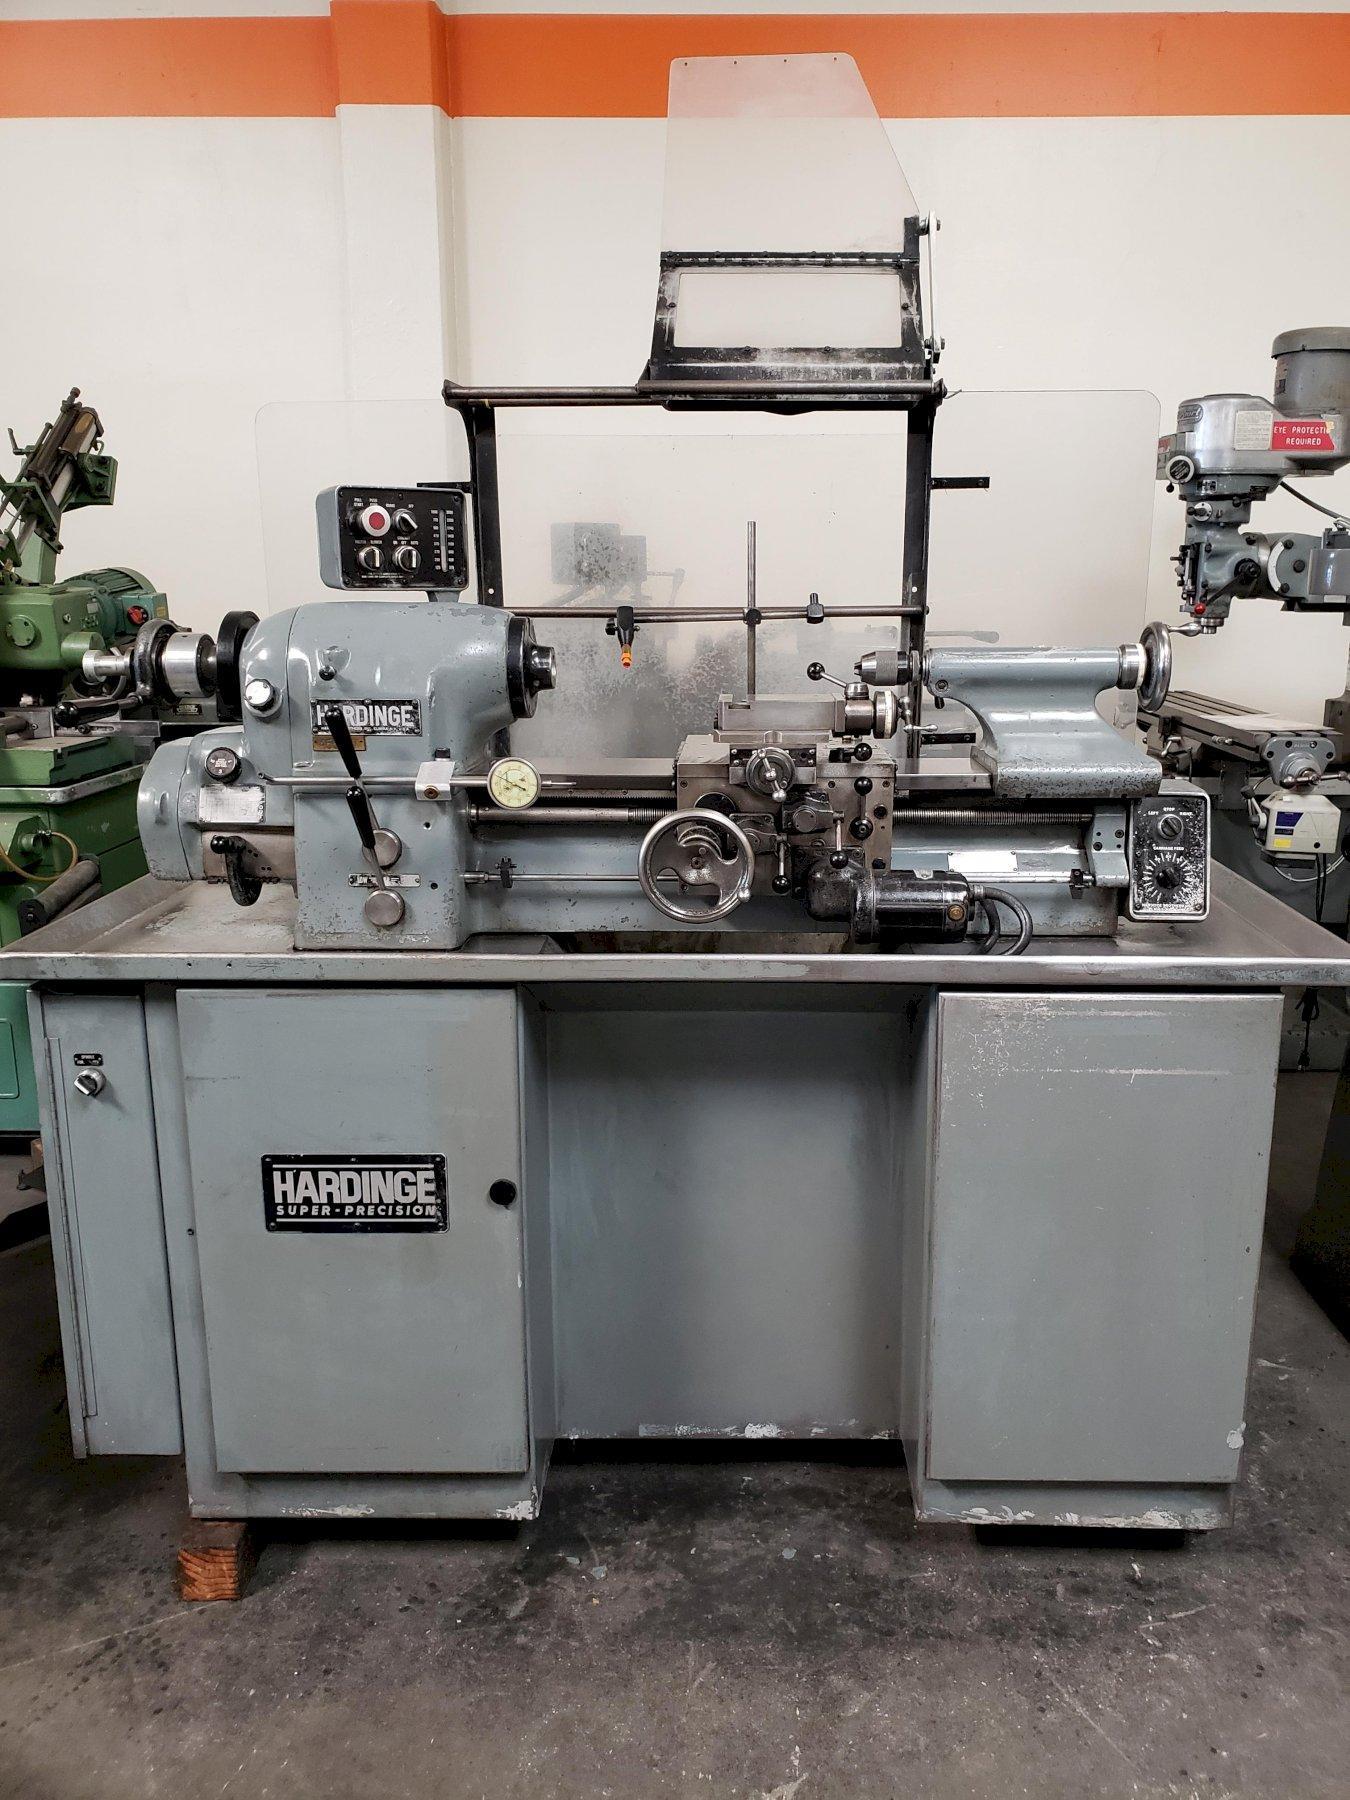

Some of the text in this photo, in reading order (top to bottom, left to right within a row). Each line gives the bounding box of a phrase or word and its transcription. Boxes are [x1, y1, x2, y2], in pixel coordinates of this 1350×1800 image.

[1273, 426, 1287, 434] EYE
[1285, 437, 1322, 446] REQUIRED
[316, 705, 414, 727] HRDINGE
[273, 1170, 437, 1204] HARDINGE
